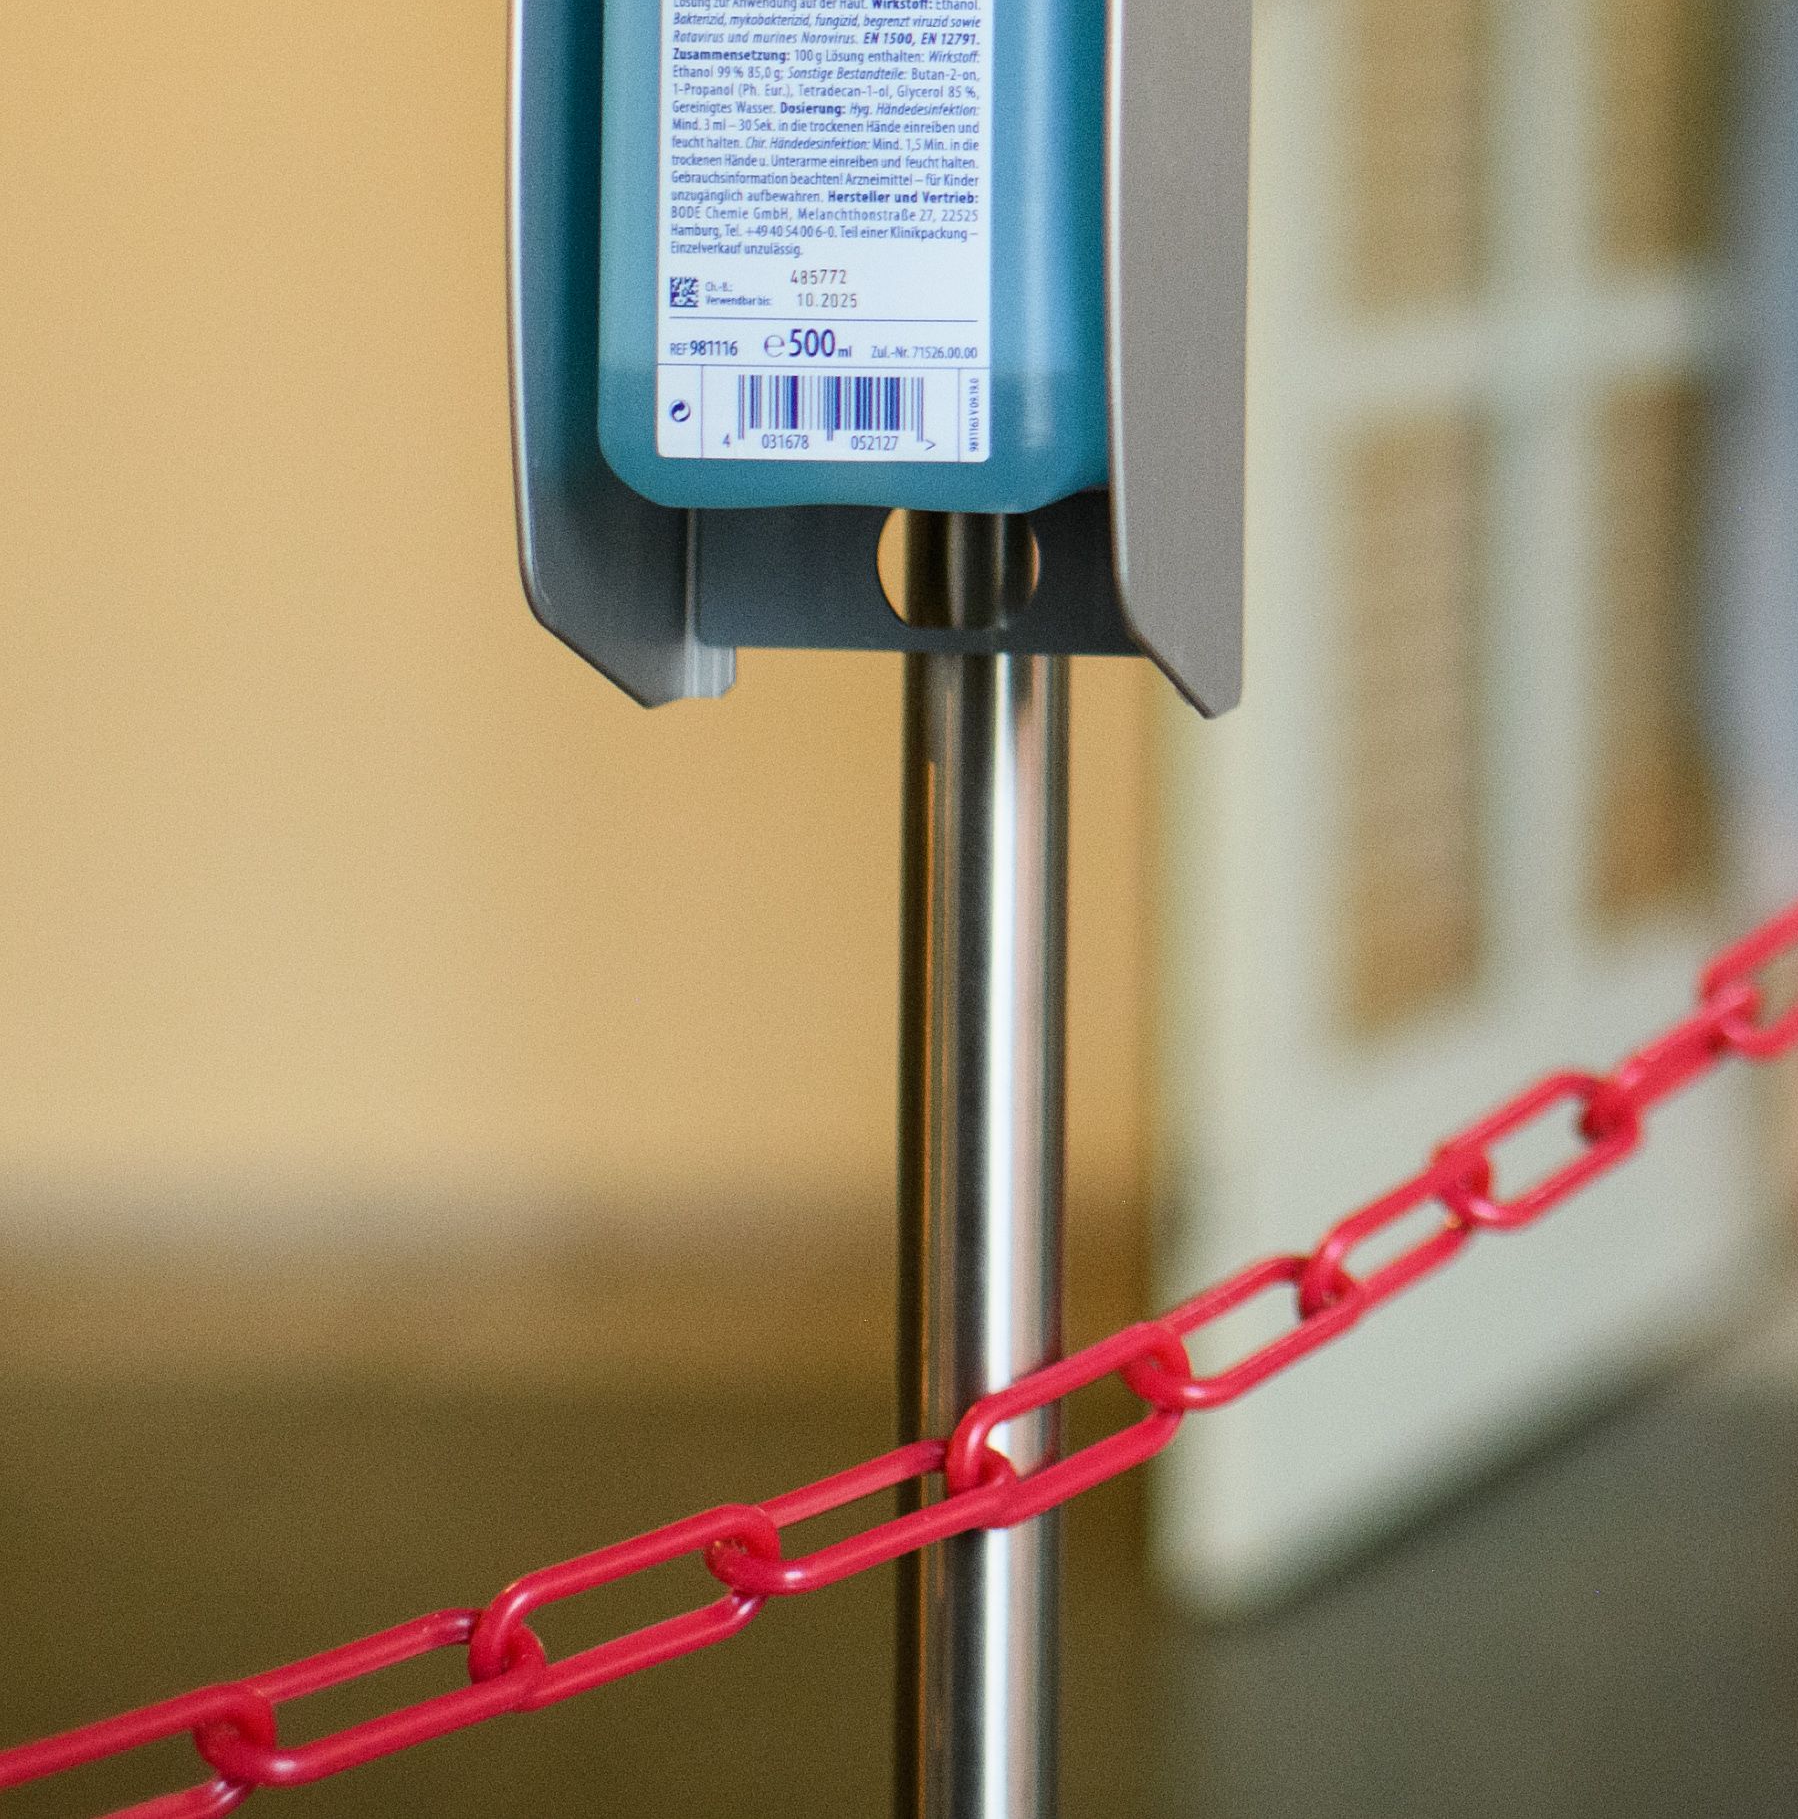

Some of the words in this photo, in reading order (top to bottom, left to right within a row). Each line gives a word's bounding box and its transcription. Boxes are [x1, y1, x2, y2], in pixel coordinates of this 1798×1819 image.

[673, 12, 727, 27] Bakterizid,
[730, 13, 811, 29] mykobakterizid,
[815, 13, 860, 30] fungizid,
[864, 14, 910, 30] begrenzt
[913, 15, 948, 28] viruzid
[951, 17, 981, 29] sowie
[672, 30, 724, 44] Rotavirus
[727, 31, 749, 44] und
[753, 31, 797, 44] murines
[802, 32, 858, 44] Norovirus.
[863, 32, 879, 44] EN
[884, 33, 915, 46] 1500,
[921, 33, 937, 45] EN
[941, 33, 980, 46] 12791.
[672, 48, 790, 64] Zusammensetzung:
[795, 49, 812, 62] 100
[815, 51, 822, 65] g
[826, 50, 864, 65] Lösung
[868, 50, 924, 63] enthalten:
[929, 50, 980, 63] Wirkstoff:
[672, 65, 713, 78] Ethanol
[717, 66, 730, 78] 99
[731, 66, 744, 78] %
[748, 66, 771, 79] 85,0
[787, 67, 833, 82] Sonstige
[837, 67, 907, 80] Bestandteile:
[911, 68, 980, 81] Butan-2-on,
[673, 83, 734, 98] 1-Propanol
[738, 84, 760, 97] (Ph.
[799, 84, 893, 99] Tetradecan-1-ol,
[897, 85, 943, 100] Glycerol
[948, 86, 962, 98] 85
[672, 100, 732, 116] Gereinigtes
[735, 101, 776, 114] Wasser.
[780, 102, 846, 117] Dosierung:
[850, 102, 872, 117] Hyg.
[877, 103, 980, 116] Händedesinfektion:
[672, 118, 701, 131] Mind.
[704, 119, 710, 131] 3
[712, 119, 726, 131] ml
[738, 119, 750, 131] 30
[753, 119, 775, 132] Sek.
[778, 120, 788, 132] in
[791, 120, 807, 132] die
[809, 120, 863, 132] trockenen
[866, 120, 901, 133] Hände
[903, 121, 955, 133] einreiben
[958, 122, 980, 134] und
[672, 135, 704, 149] feucht
[707, 136, 743, 149] halten.
[745, 136, 768, 149] Chir.
[873, 138, 903, 150] Mind.
[906, 138, 921, 152] 1,5
[924, 139, 948, 151] Min.
[950, 139, 960, 151] in
[963, 139, 980, 151] die
[671, 153, 722, 166] trockenen
[725, 154, 759, 166] Hände
[771, 155, 827, 167] Unterarme
[829, 155, 878, 168] einreiben
[880, 156, 901, 168] und
[905, 156, 939, 169] feucht
[941, 156, 979, 169] halten.
[672, 170, 788, 185] Gebrauchsinformation
[845, 173, 913, 187] Arzneimittel
[926, 173, 940, 187] für
[943, 174, 979, 187] Kinder
[671, 190, 743, 205] unzugänglich
[747, 189, 824, 202] aufbewahren.
[828, 190, 890, 203] Hersteller
[894, 191, 918, 203] und
[922, 191, 979, 204] Vertrieb:
[671, 206, 701, 219] BODE
[705, 206, 749, 220] Chemie
[753, 207, 792, 222] GmbH,
[798, 207, 916, 221] Melanchthonstraße
[919, 209, 936, 223] 27,
[941, 209, 979, 222] 22525
[670, 223, 722, 240] Hamburg,
[725, 224, 743, 237] Tel.
[770, 225, 783, 237] 40
[840, 225, 858, 238] Teil
[860, 226, 889, 238] einer
[890, 226, 968, 242] Klinikpackung
[670, 241, 742, 255] Einzelverkauf
[744, 242, 803, 259] unzulässig.
[790, 269, 846, 285] 485772
[705, 295, 755, 307] Verwendbar
[797, 293, 858, 308] 10.2025
[670, 342, 688, 356] REF
[689, 340, 738, 356] 981116
[788, 328, 835, 357] 500
[837, 345, 852, 358] ml
[871, 345, 909, 358] Zul.-Nr.
[912, 346, 978, 359] 71526.00.00
[722, 433, 731, 448] 4
[762, 434, 810, 449] 031678
[851, 435, 899, 451] 052127
